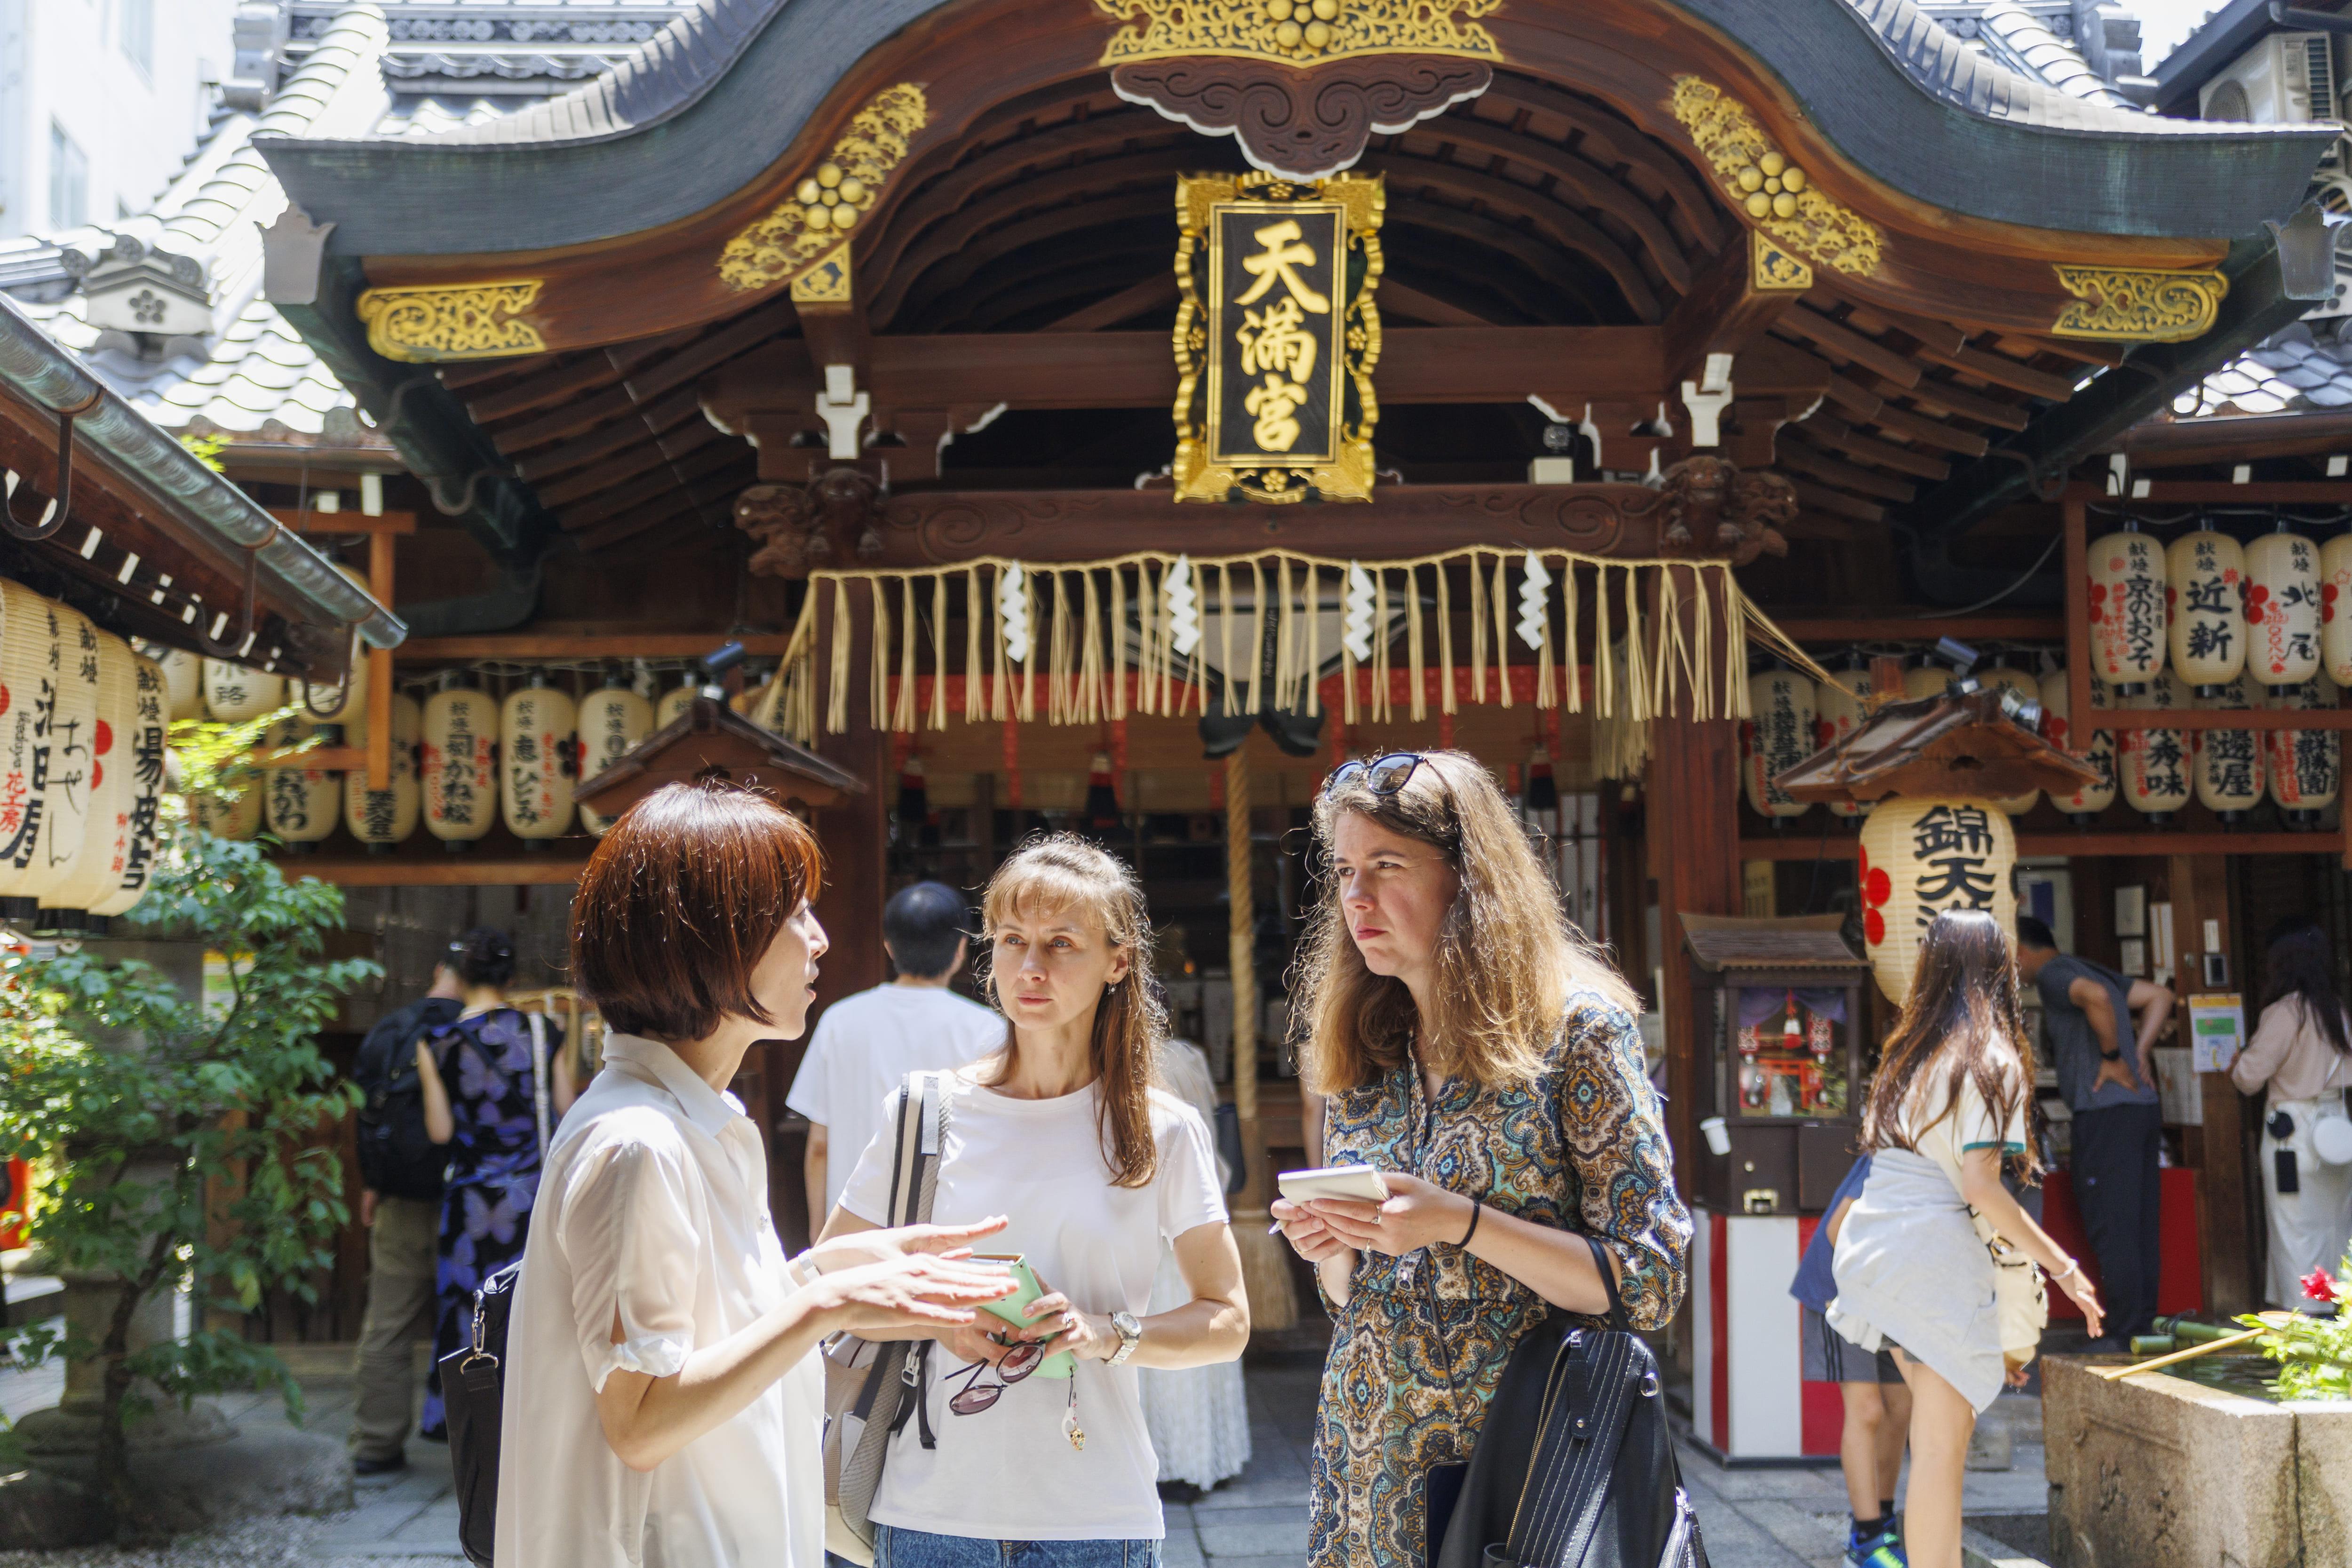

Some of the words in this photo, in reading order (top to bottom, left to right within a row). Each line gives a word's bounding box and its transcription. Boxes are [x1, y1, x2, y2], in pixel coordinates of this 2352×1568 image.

[1233, 218, 1330, 453] 天満宮
[2125, 574, 2154, 671] 京のおへそ
[2185, 575, 2233, 661] 近新
[2280, 580, 2316, 661] 北尾
[0, 770, 27, 834] 花工房
[1912, 804, 1997, 944] 錦天
